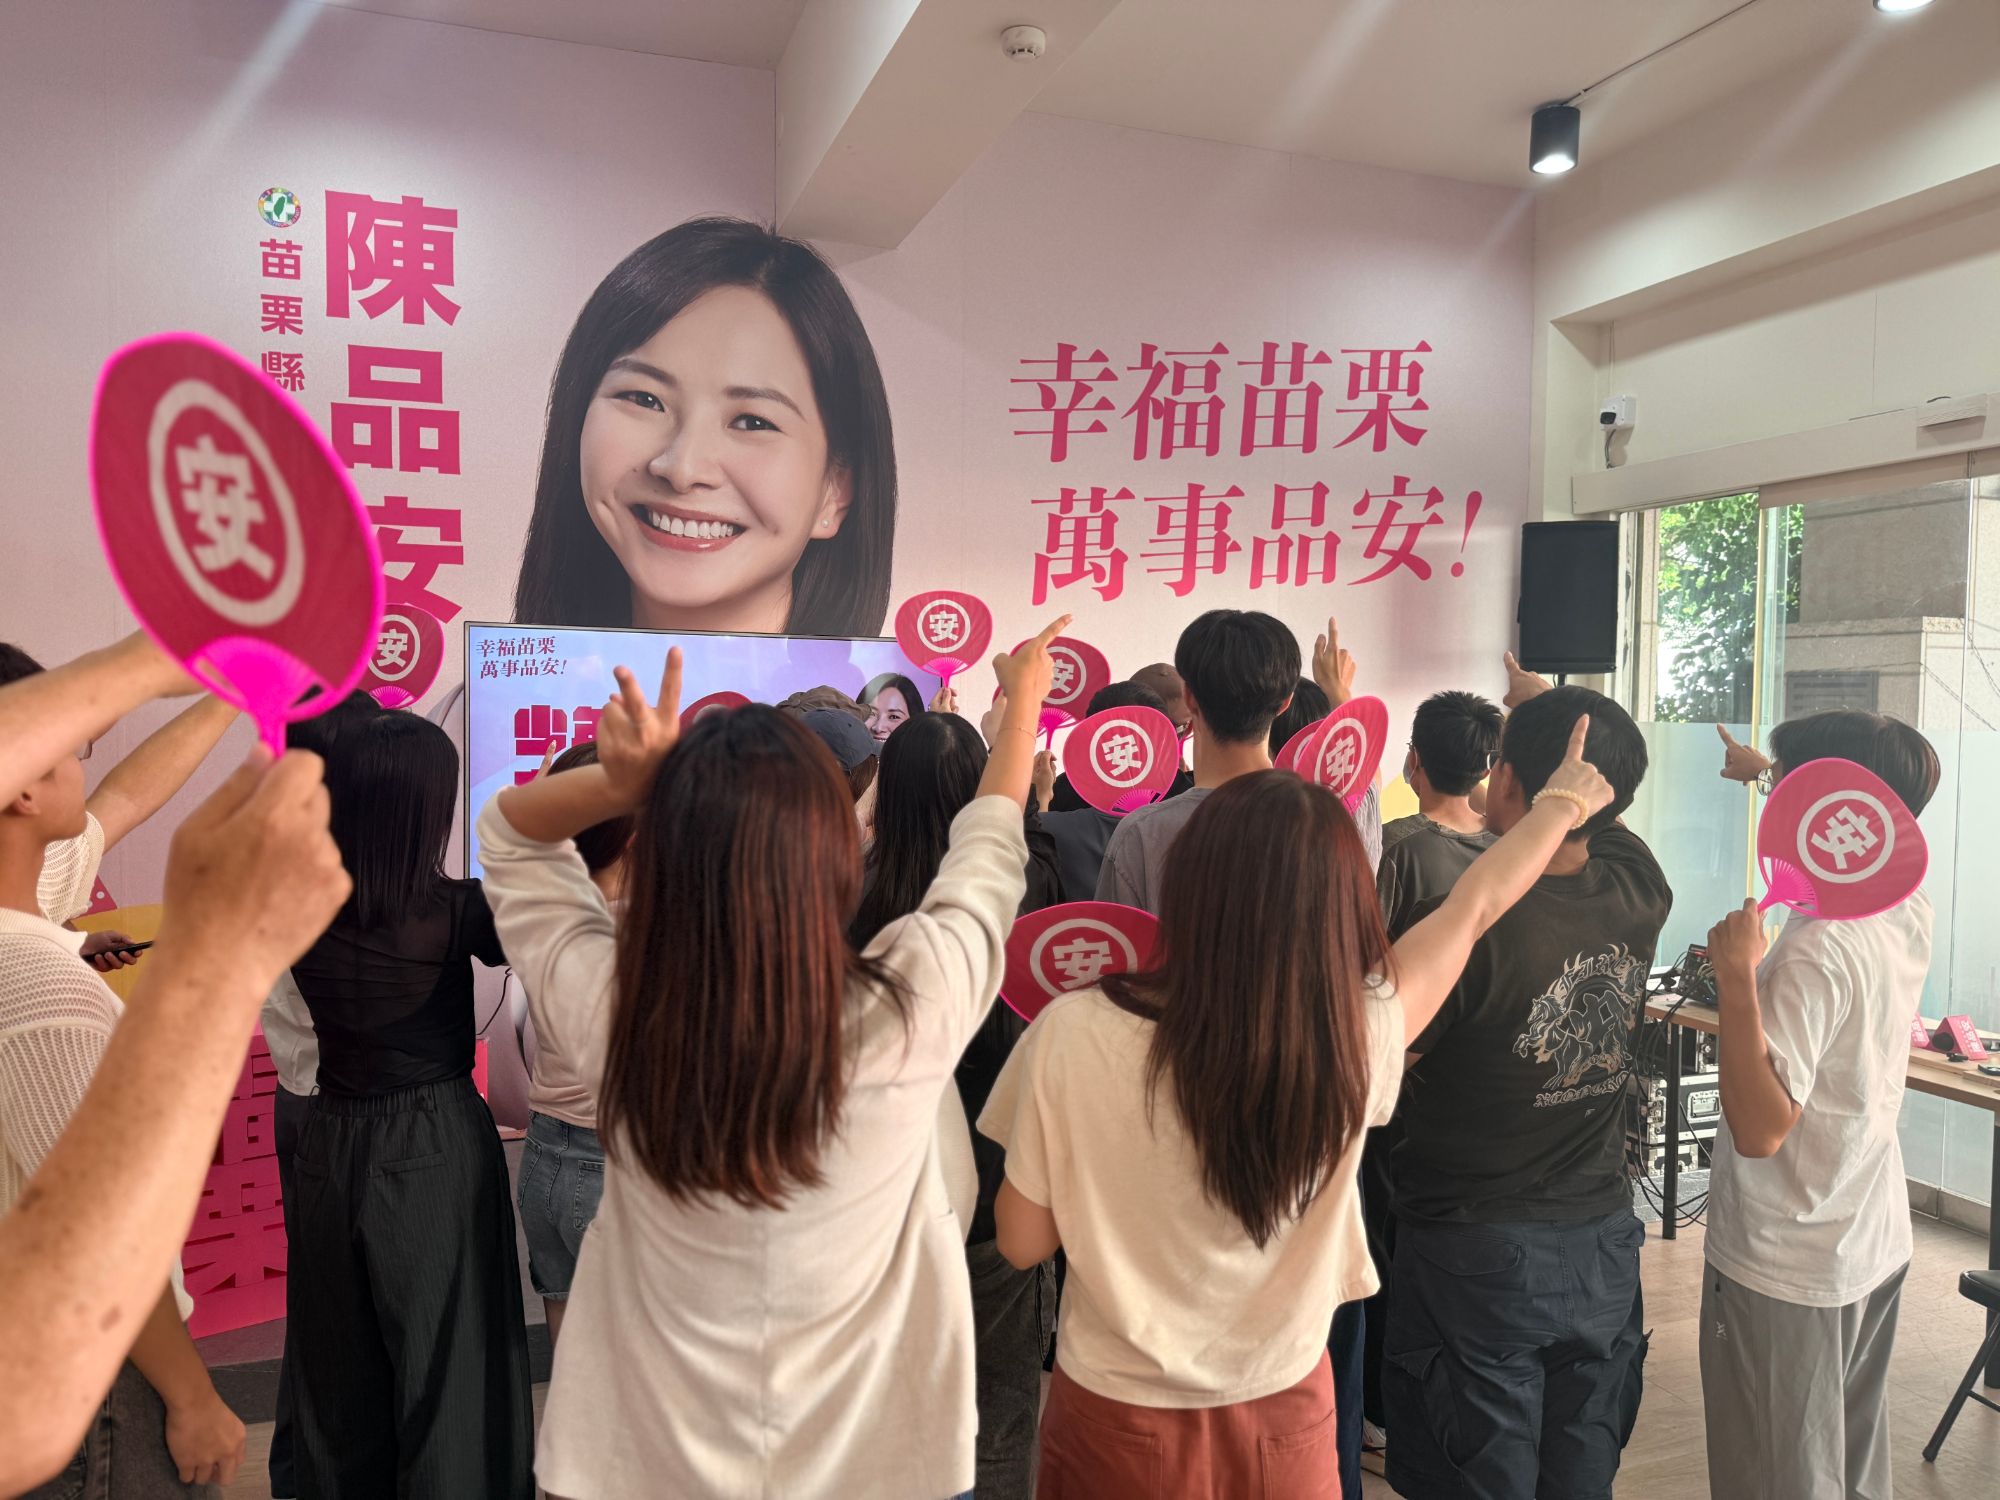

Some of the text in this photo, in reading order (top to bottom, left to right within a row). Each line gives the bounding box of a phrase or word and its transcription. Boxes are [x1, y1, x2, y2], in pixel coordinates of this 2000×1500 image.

[259, 238, 305, 392] 苗栗縣
[325, 190, 465, 624] 陳品安
[1008, 340, 1433, 463] 幸福苗栗
[176, 434, 276, 583] 安
[1031, 475, 1483, 606] 萬事品安!
[376, 628, 409, 668] 安
[475, 636, 557, 658] 幸福苗栗
[929, 610, 959, 643] 安
[480, 657, 568, 680] 萬事品安!
[1049, 658, 1076, 695] 安
[1102, 734, 1143, 777] 安
[1326, 734, 1355, 788] 安
[1811, 805, 1879, 870] 安
[1053, 937, 1113, 991] 安
